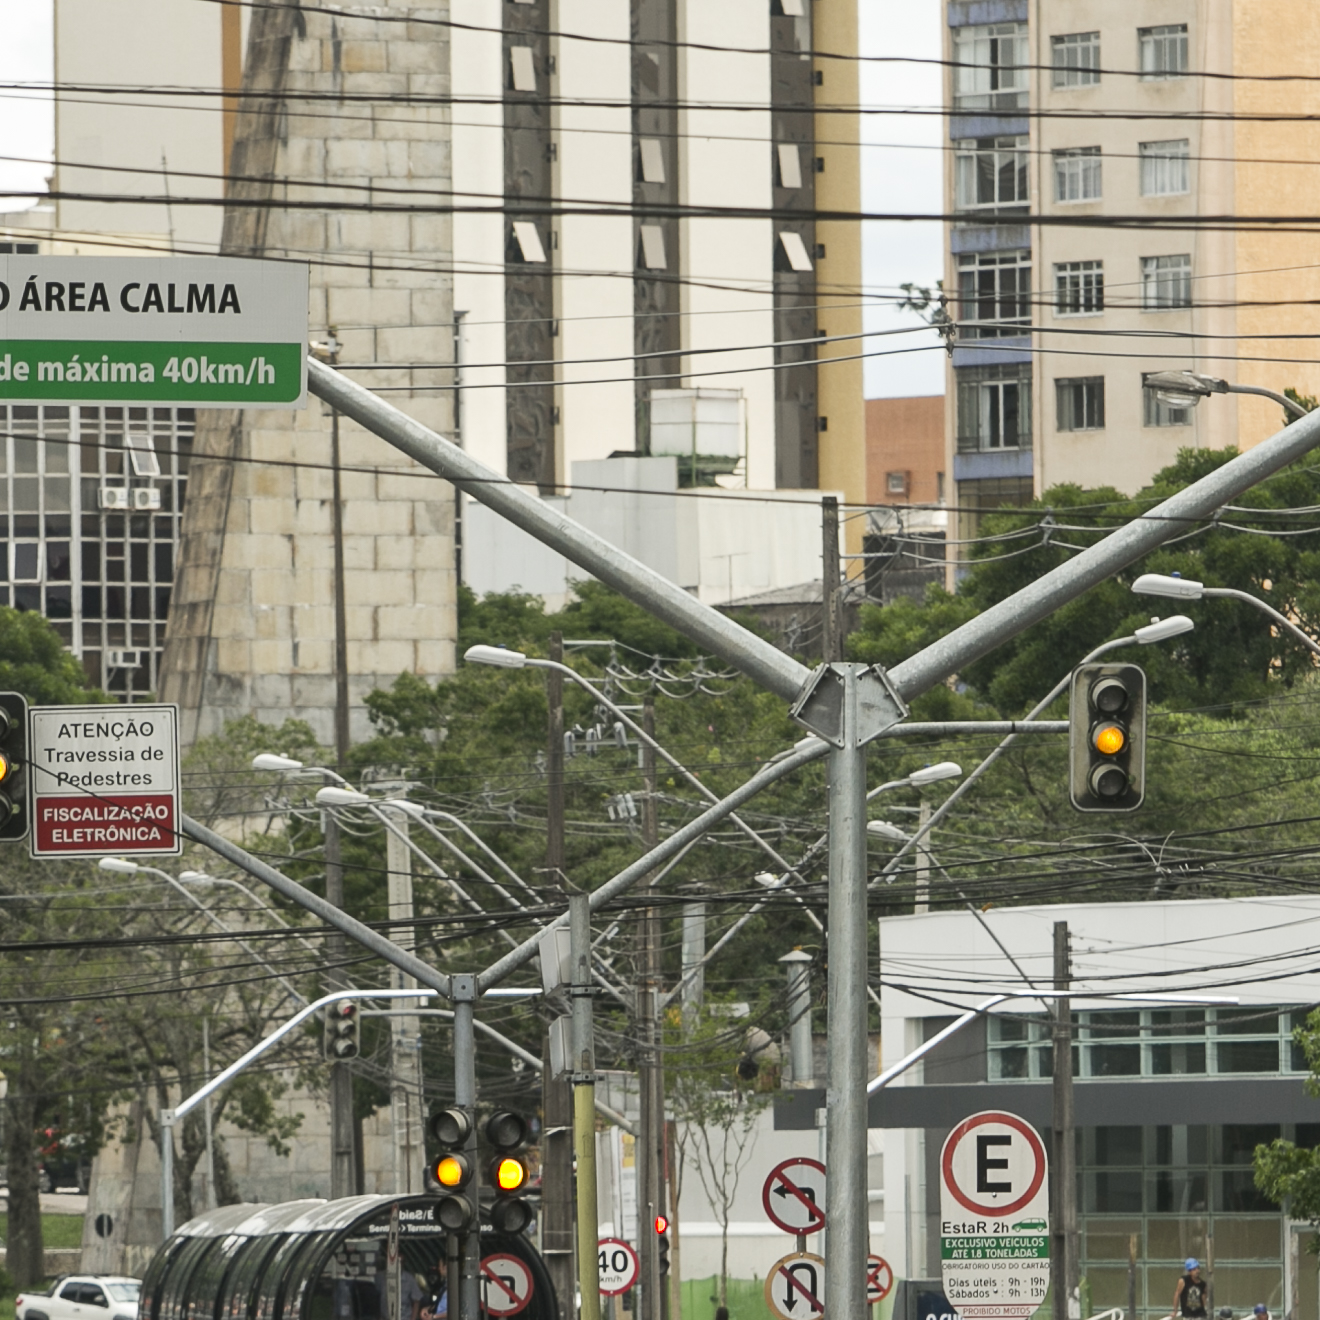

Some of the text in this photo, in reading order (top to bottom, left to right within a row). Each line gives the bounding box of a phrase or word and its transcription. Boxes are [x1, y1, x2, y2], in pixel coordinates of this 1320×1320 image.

[19, 275, 112, 313] ÁREA
[120, 282, 242, 315] CALMA
[38, 355, 155, 384] máxima
[163, 356, 276, 386] 40km/h
[58, 719, 154, 741] ATENÇÃO
[44, 746, 164, 763] Travessia de
[57, 771, 153, 787] Pedestres
[43, 803, 169, 823] FISCALIZAÇÃO
[52, 825, 161, 843] ELETRÔNICA
[977, 1135, 1012, 1193] E
[942, 1221, 1009, 1234] EstaR 2h
[945, 1237, 1045, 1248] EXCLUSIVO VEÍCULOS
[952, 1248, 969, 1258] ATÉ
[985, 1249, 1038, 1258] TONELADAS
[598, 1250, 628, 1273] 40
[992, 1262, 1006, 1270] USO
[1009, 1262, 1019, 1270] DO
[1021, 1261, 1050, 1270] CARTÃO
[949, 1278, 969, 1287] Dias
[973, 1277, 997, 1287] úteis
[1008, 1278, 1020, 1287] 9h
[1030, 1277, 1045, 1286] 19h
[949, 1289, 990, 1298] Sábados
[1008, 1289, 1020, 1297] 9h
[1030, 1288, 1045, 1297] 13h
[963, 1307, 1031, 1315] PROIBIDO MOTOS
